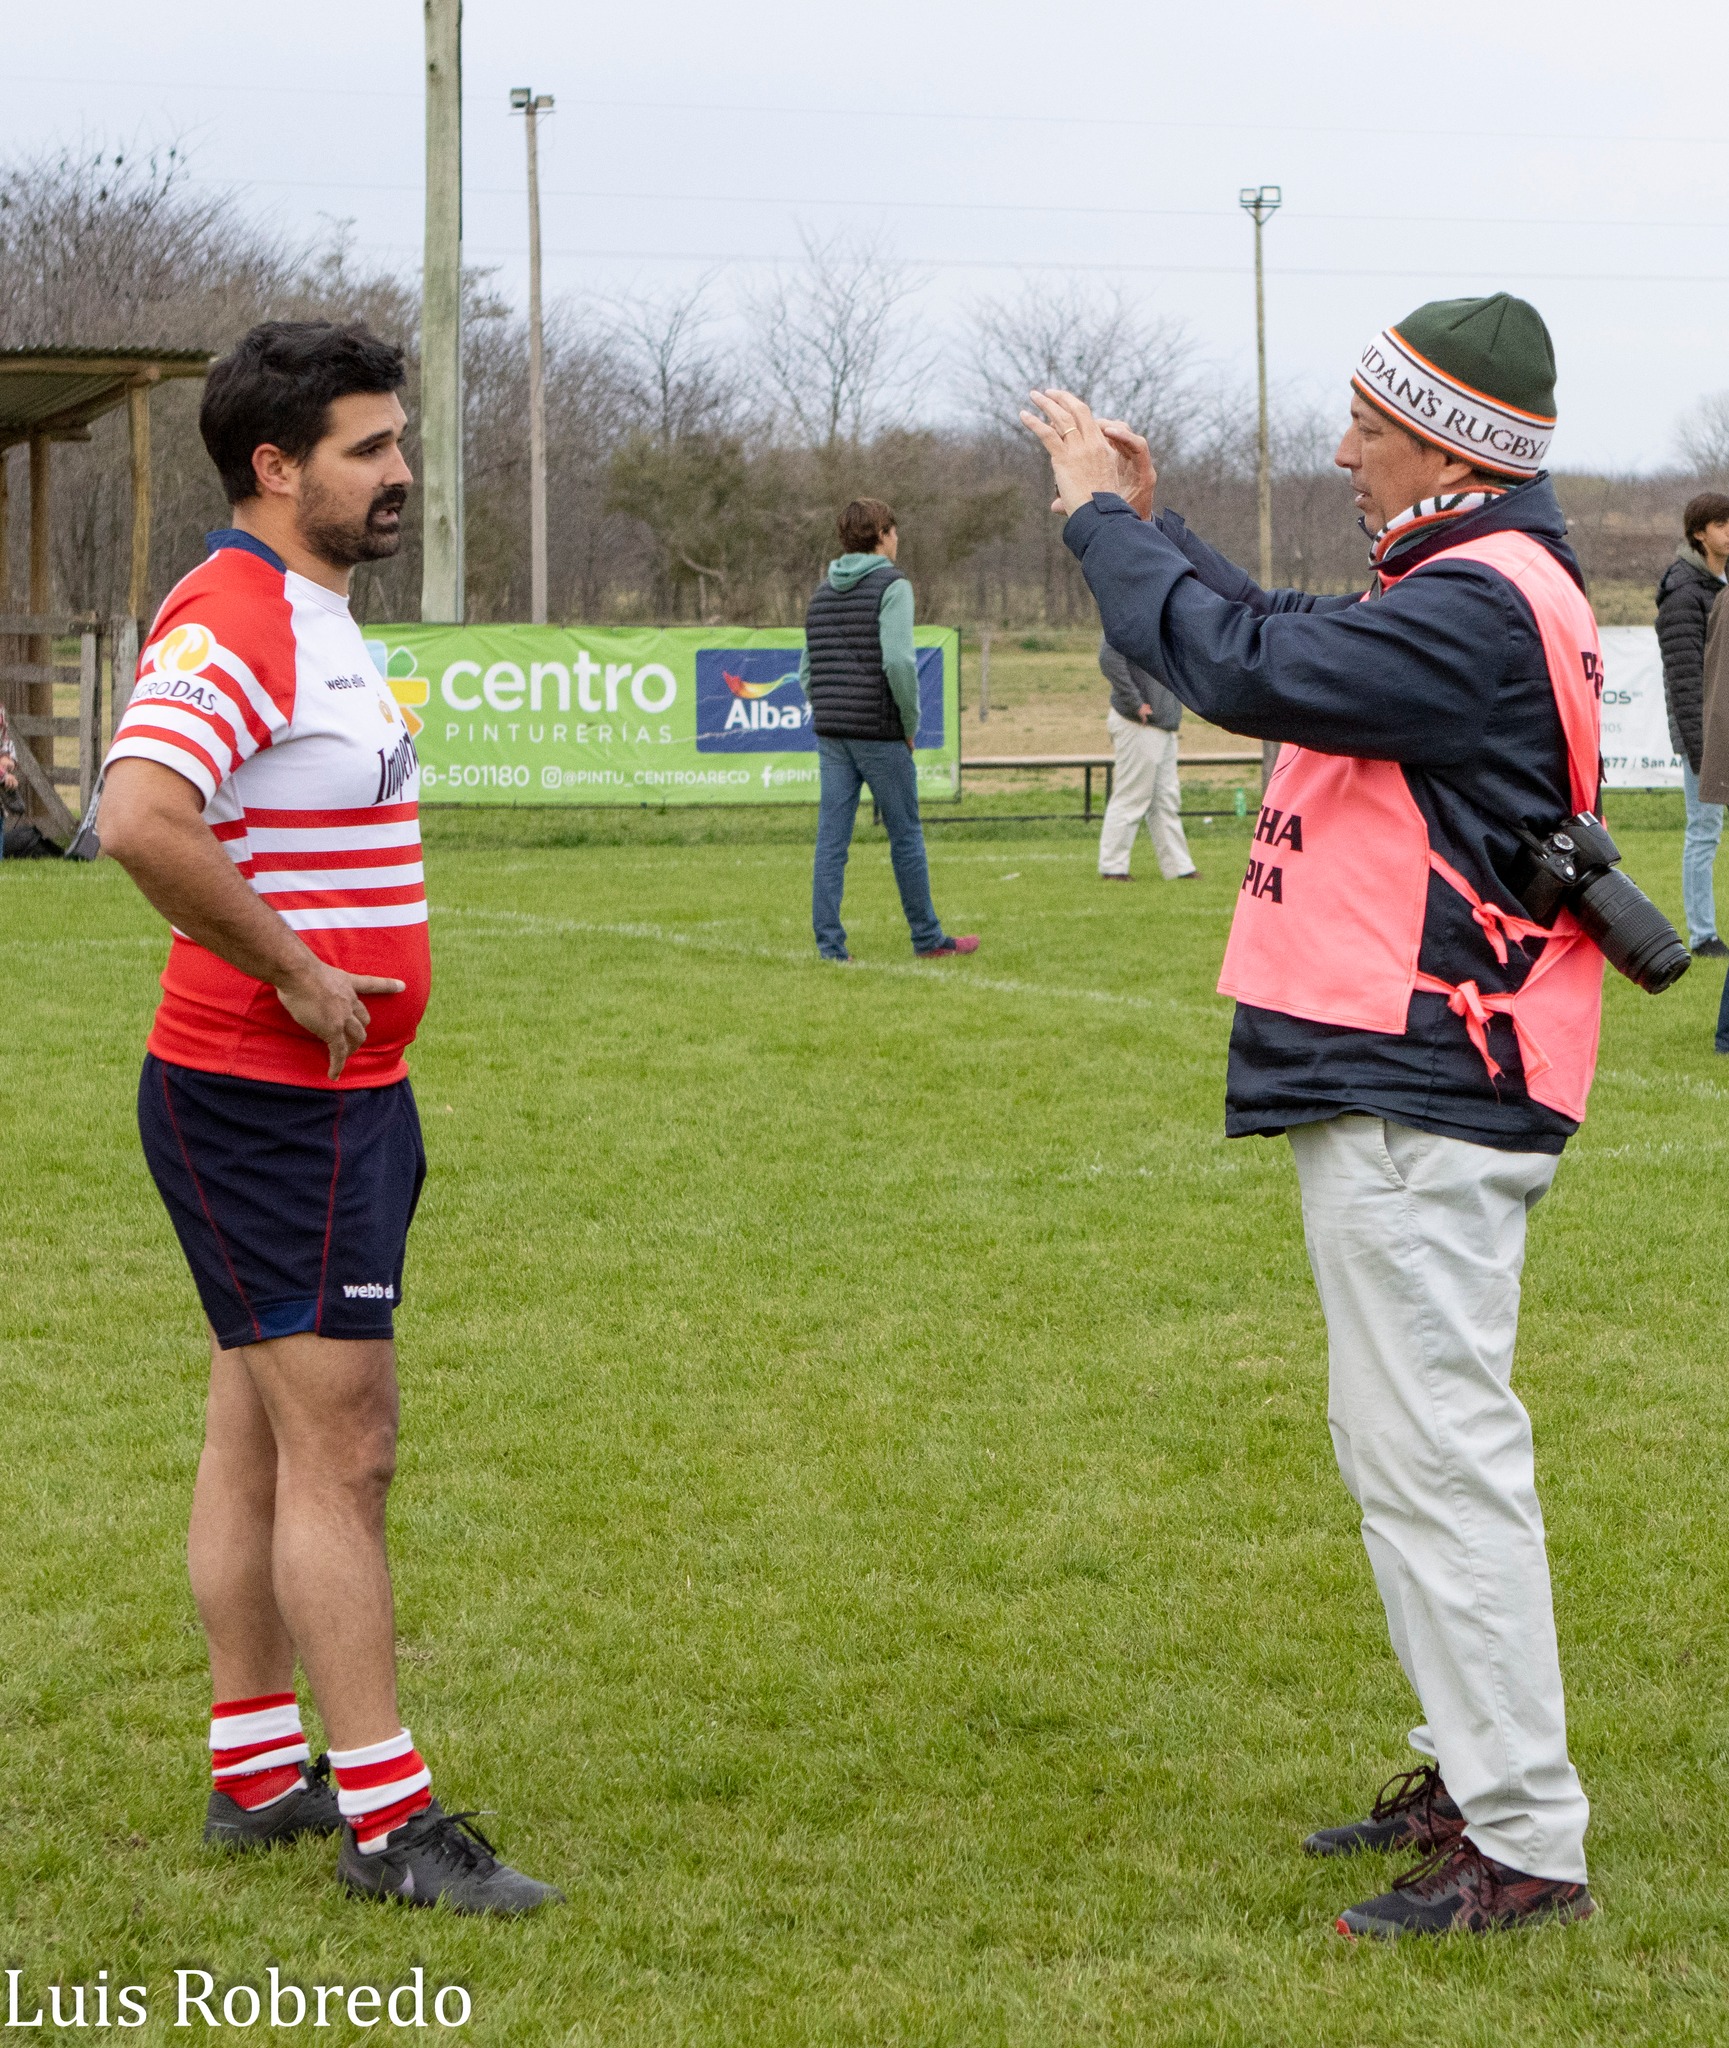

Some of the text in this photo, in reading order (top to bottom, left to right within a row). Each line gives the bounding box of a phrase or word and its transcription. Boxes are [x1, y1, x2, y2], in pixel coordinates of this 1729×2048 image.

[1442, 406, 1544, 460] RUGBY
[132, 680, 217, 711] GRODAS
[324, 675, 352, 690] webb
[441, 651, 677, 713] centro
[724, 699, 801, 730] Alba
[445, 722, 672, 744] PINTURERÍAS
[1640, 756, 1665, 769] San
[1253, 805, 1304, 853] HA
[342, 1283, 384, 1299] webb
